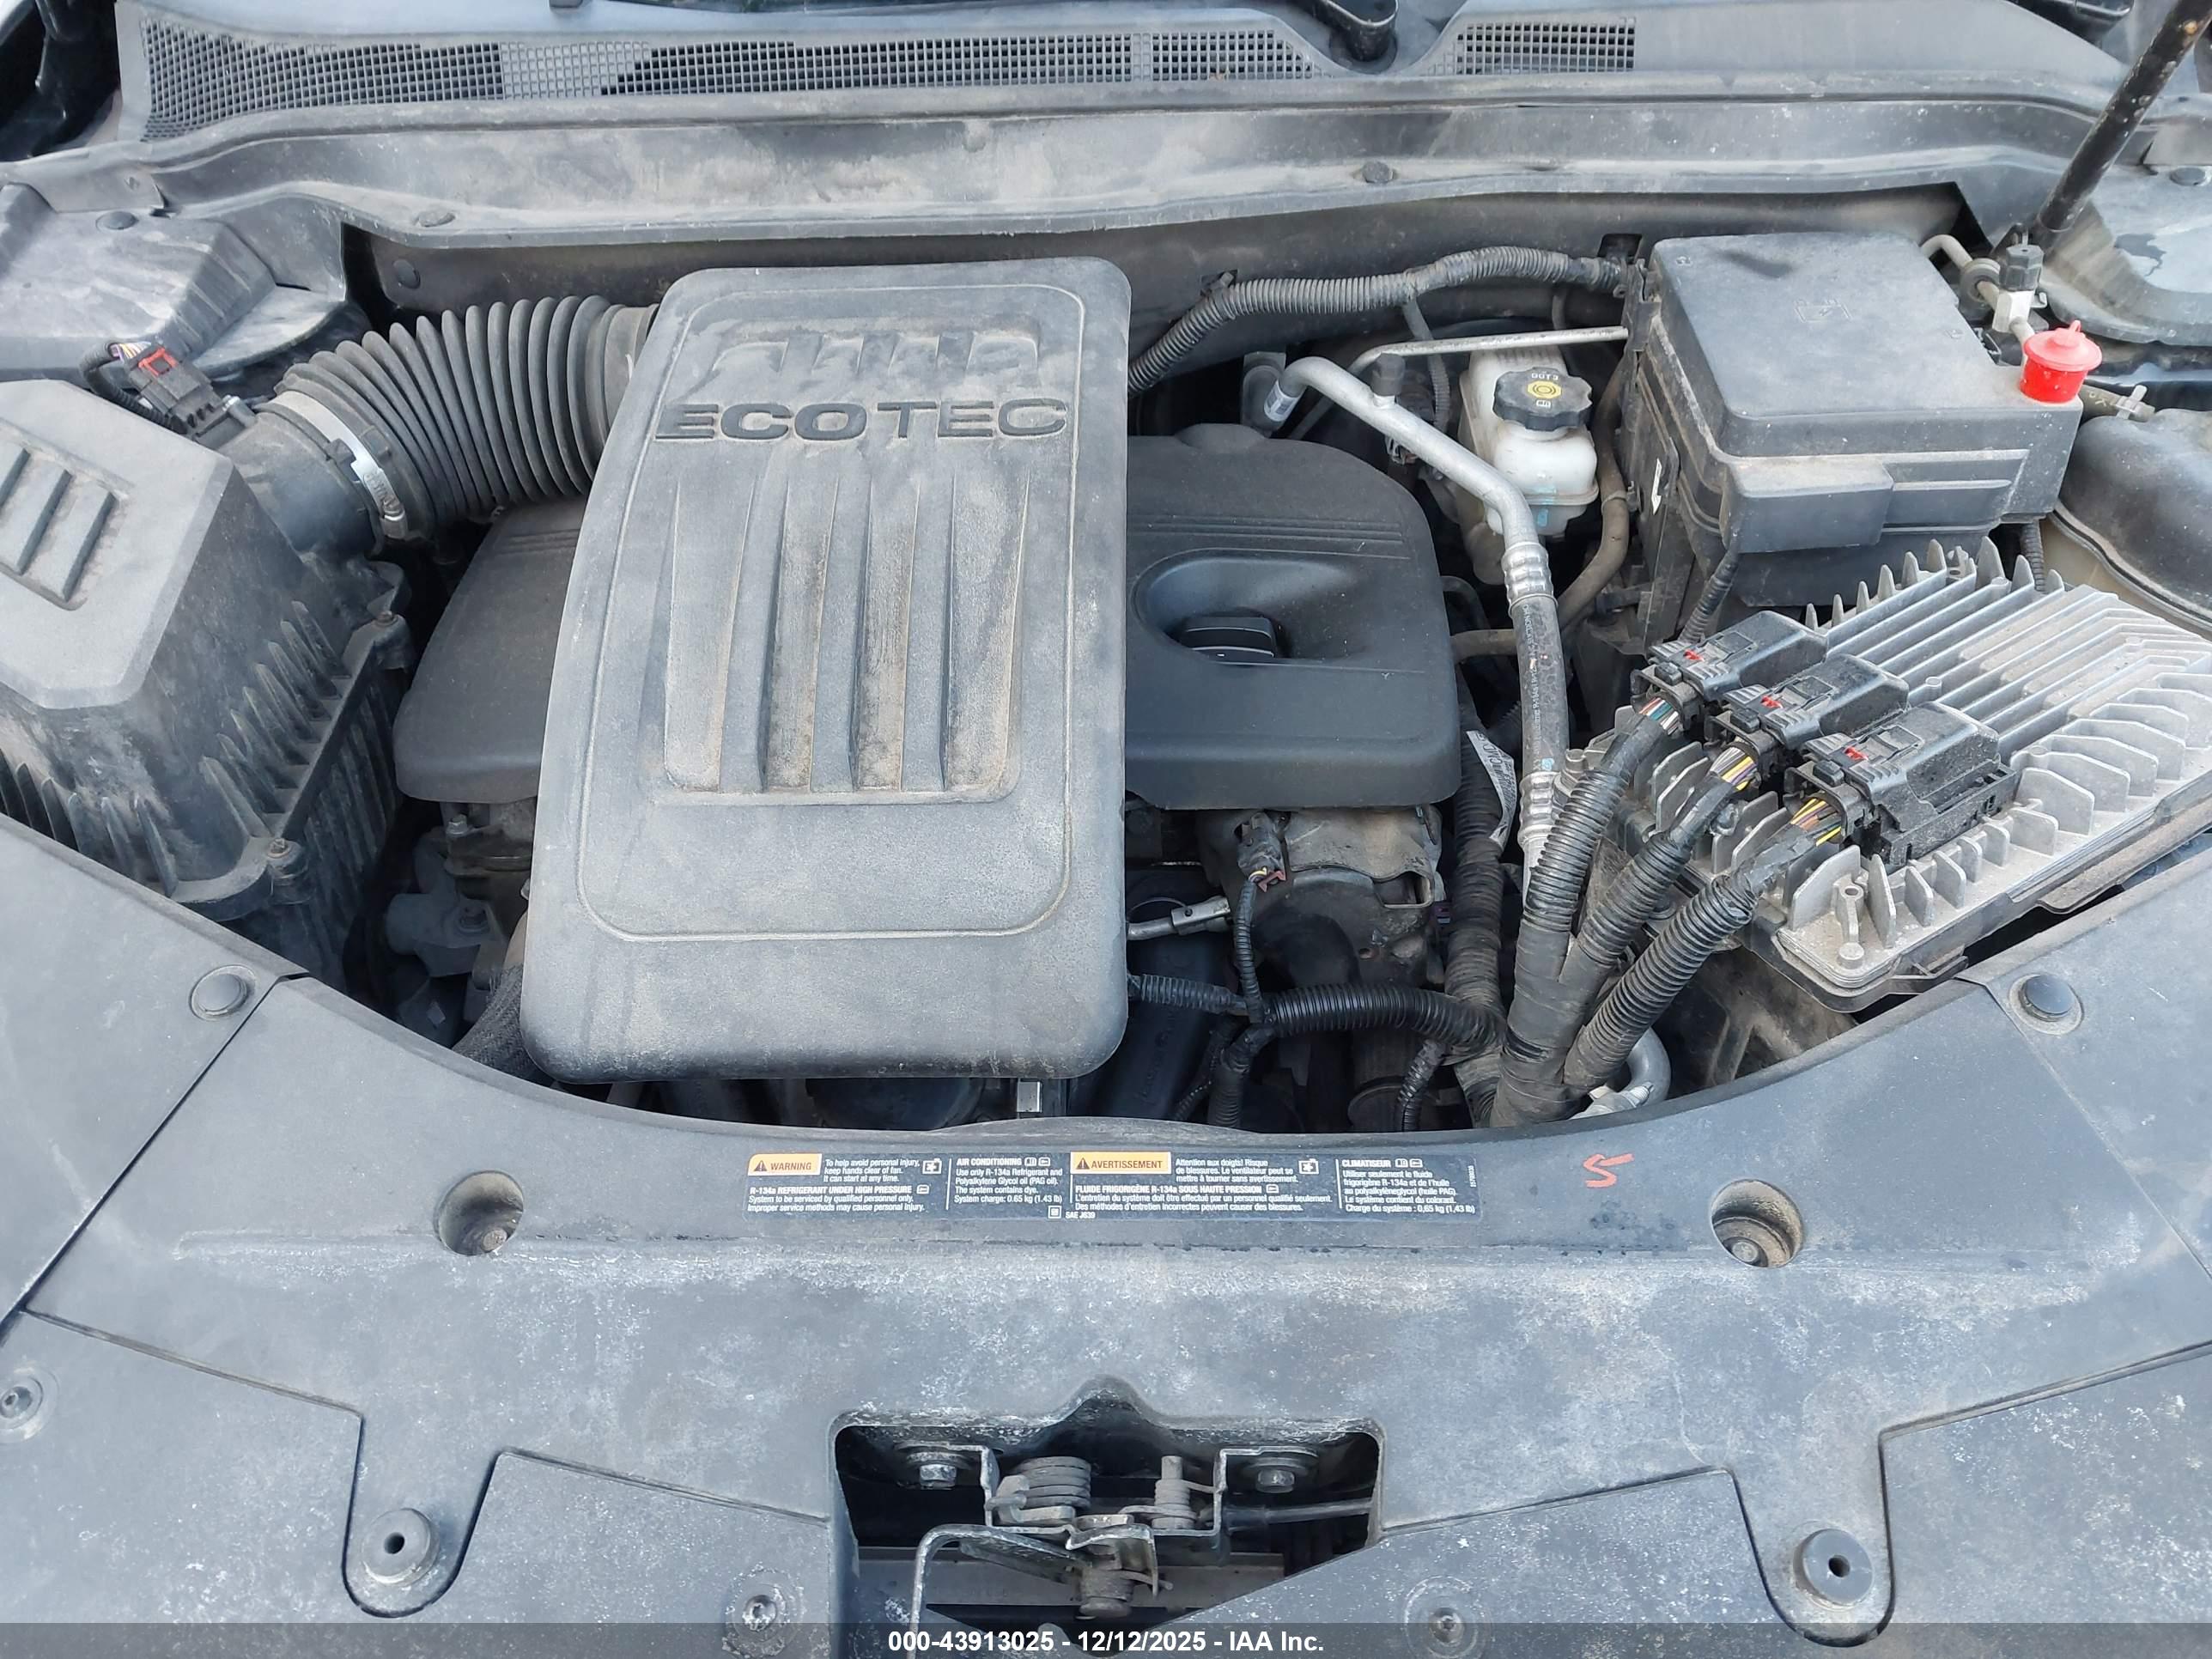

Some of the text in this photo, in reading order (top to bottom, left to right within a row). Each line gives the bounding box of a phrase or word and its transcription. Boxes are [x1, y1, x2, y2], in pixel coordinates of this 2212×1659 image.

[655, 398, 1066, 441] ECOTEC
[770, 1162, 811, 1170] WARNING
[1342, 1159, 1391, 1168] CLIMATISEUR
[1012, 1168, 1048, 1176] Refrigerant
[1103, 1184, 1150, 1193] FRIGORIGÈNE
[1225, 1185, 1262, 1194] PRESSION
[749, 1195, 774, 1204] System
[824, 1195, 832, 1204] by
[954, 1195, 979, 1204] System
[981, 1195, 1006, 1204] charge:
[1024, 1195, 1032, 1204] kg
[748, 1204, 777, 1212] Improper
[1346, 1205, 1370, 1213] Charge
[1436, 1205, 1444, 1213] kg
